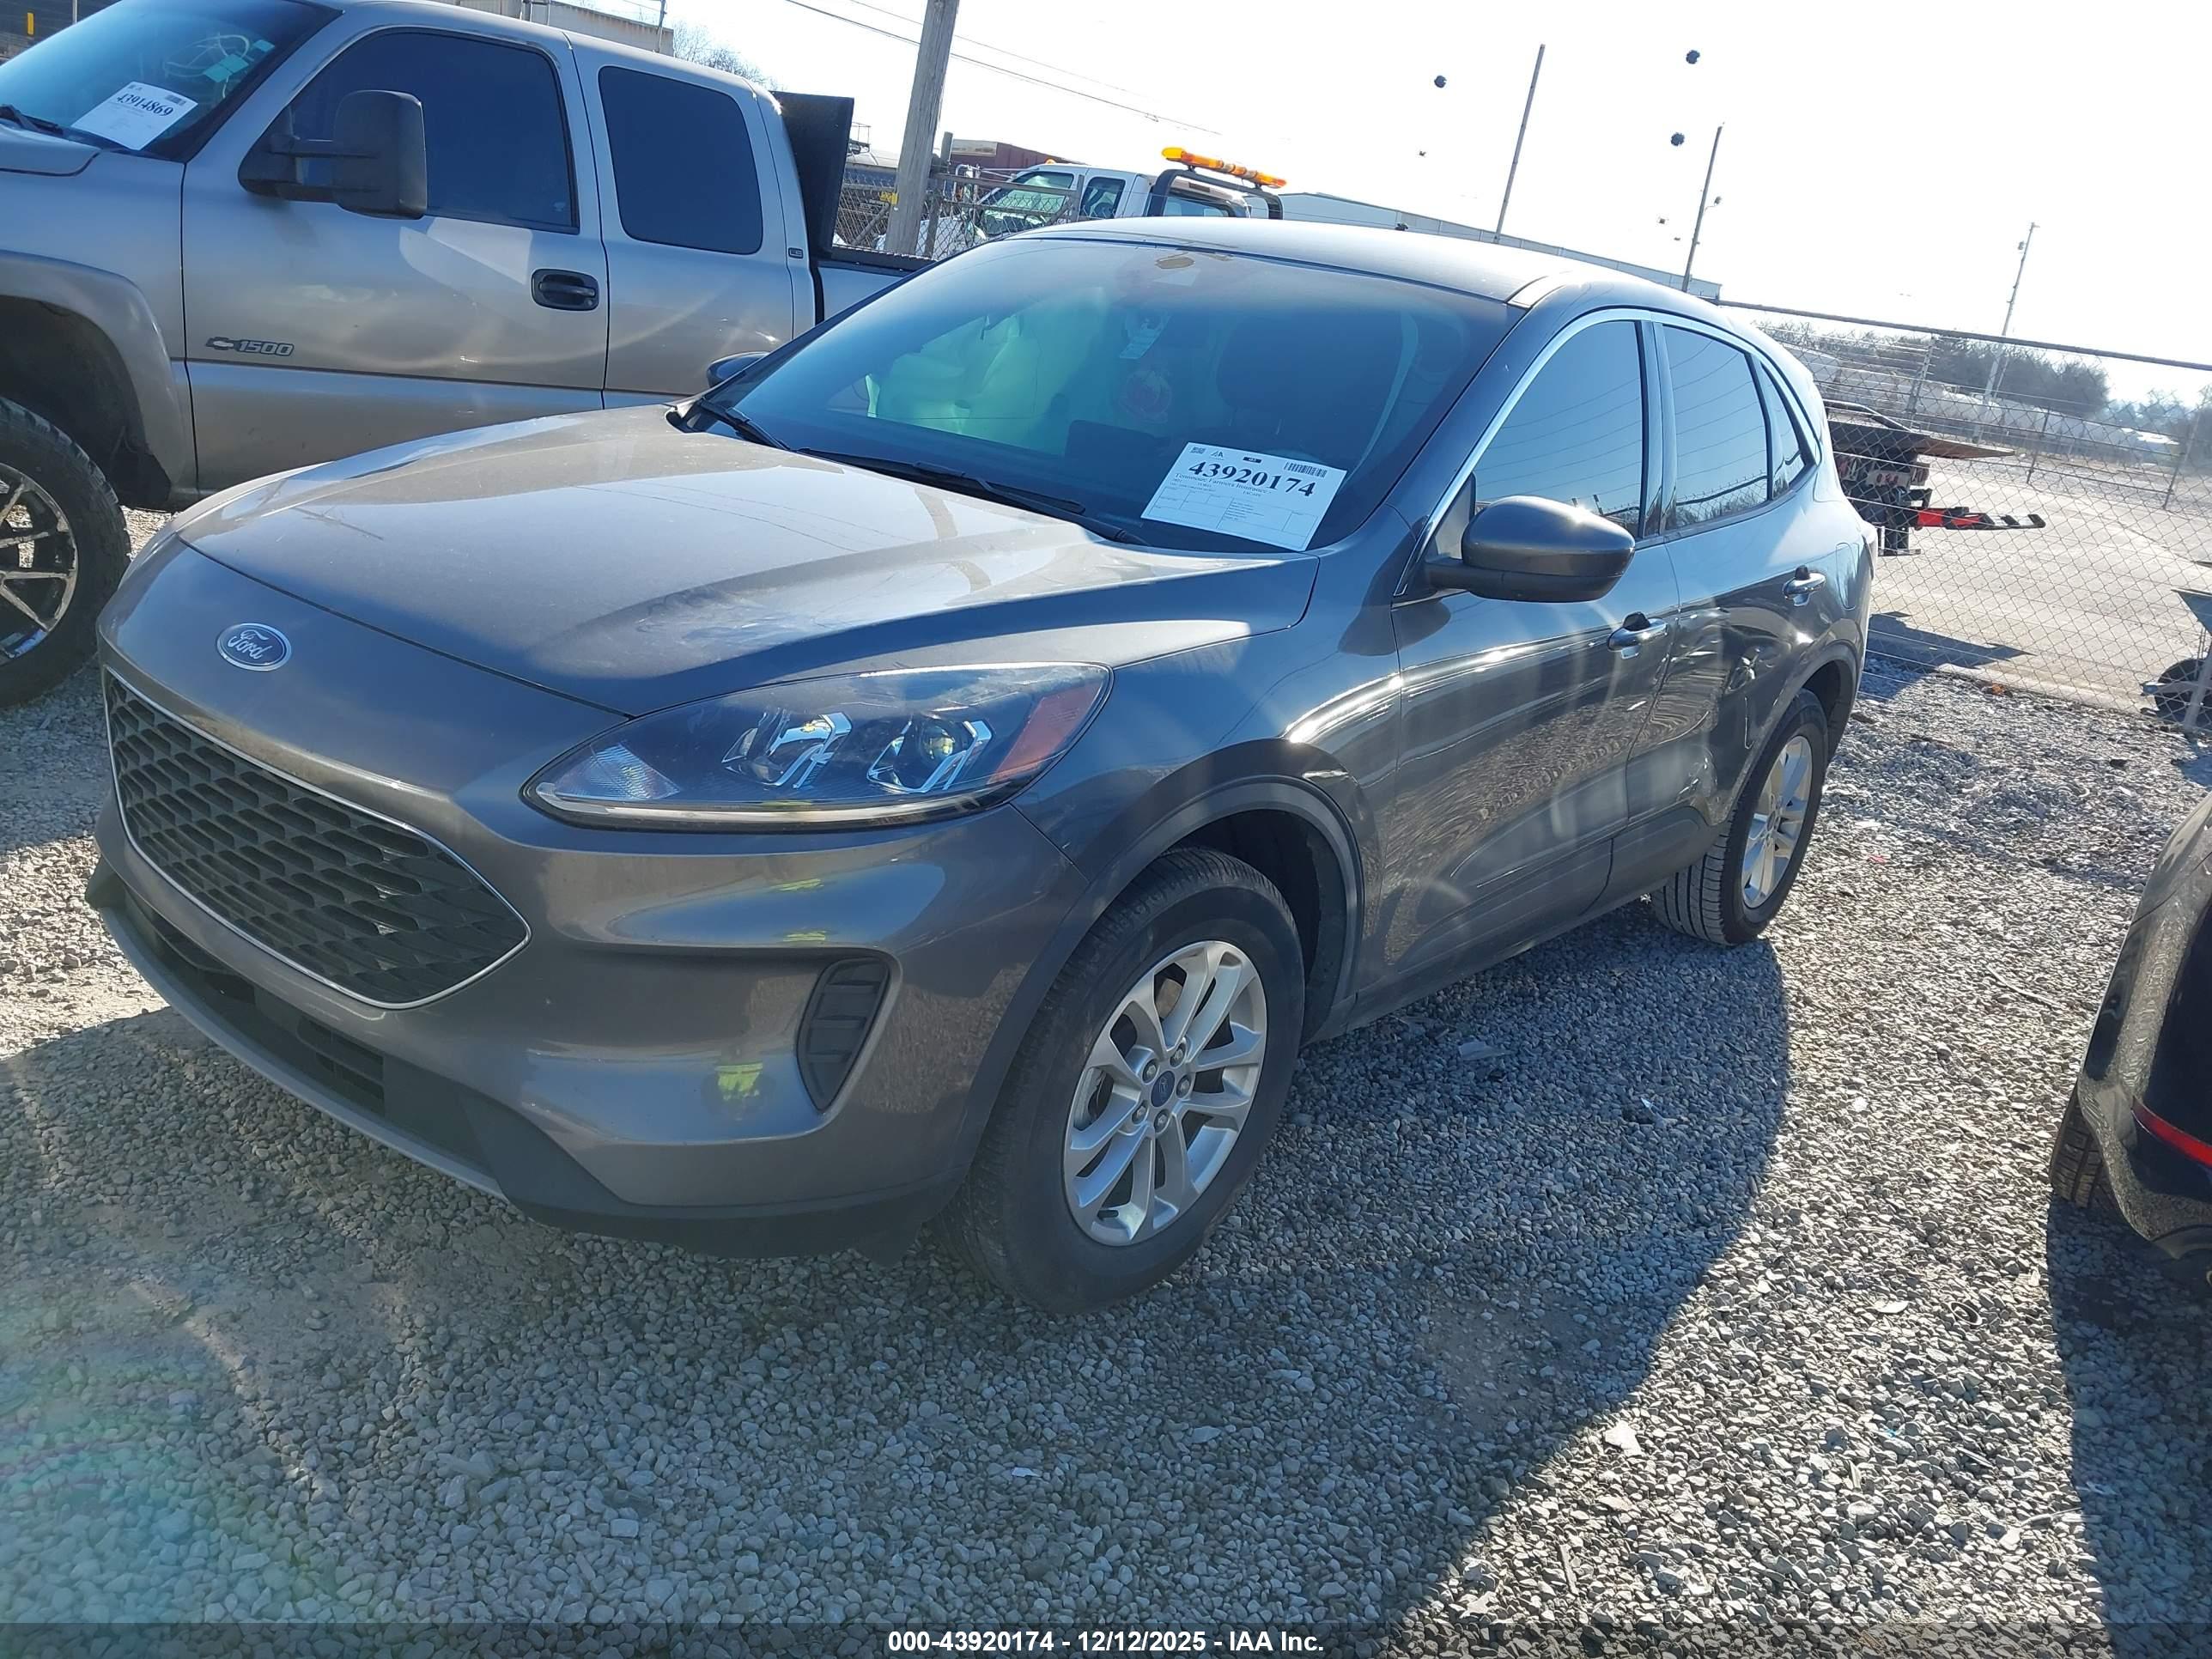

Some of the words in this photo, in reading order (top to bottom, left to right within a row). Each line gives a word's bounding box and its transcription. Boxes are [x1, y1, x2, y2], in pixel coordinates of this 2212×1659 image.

[117, 93, 173, 117] 43914869
[240, 340, 294, 356] 1500
[1188, 461, 1316, 497] 43920174
[1208, 478, 1235, 488] Farmers
[1236, 483, 1267, 494] Insurance
[227, 629, 274, 660] Ford
